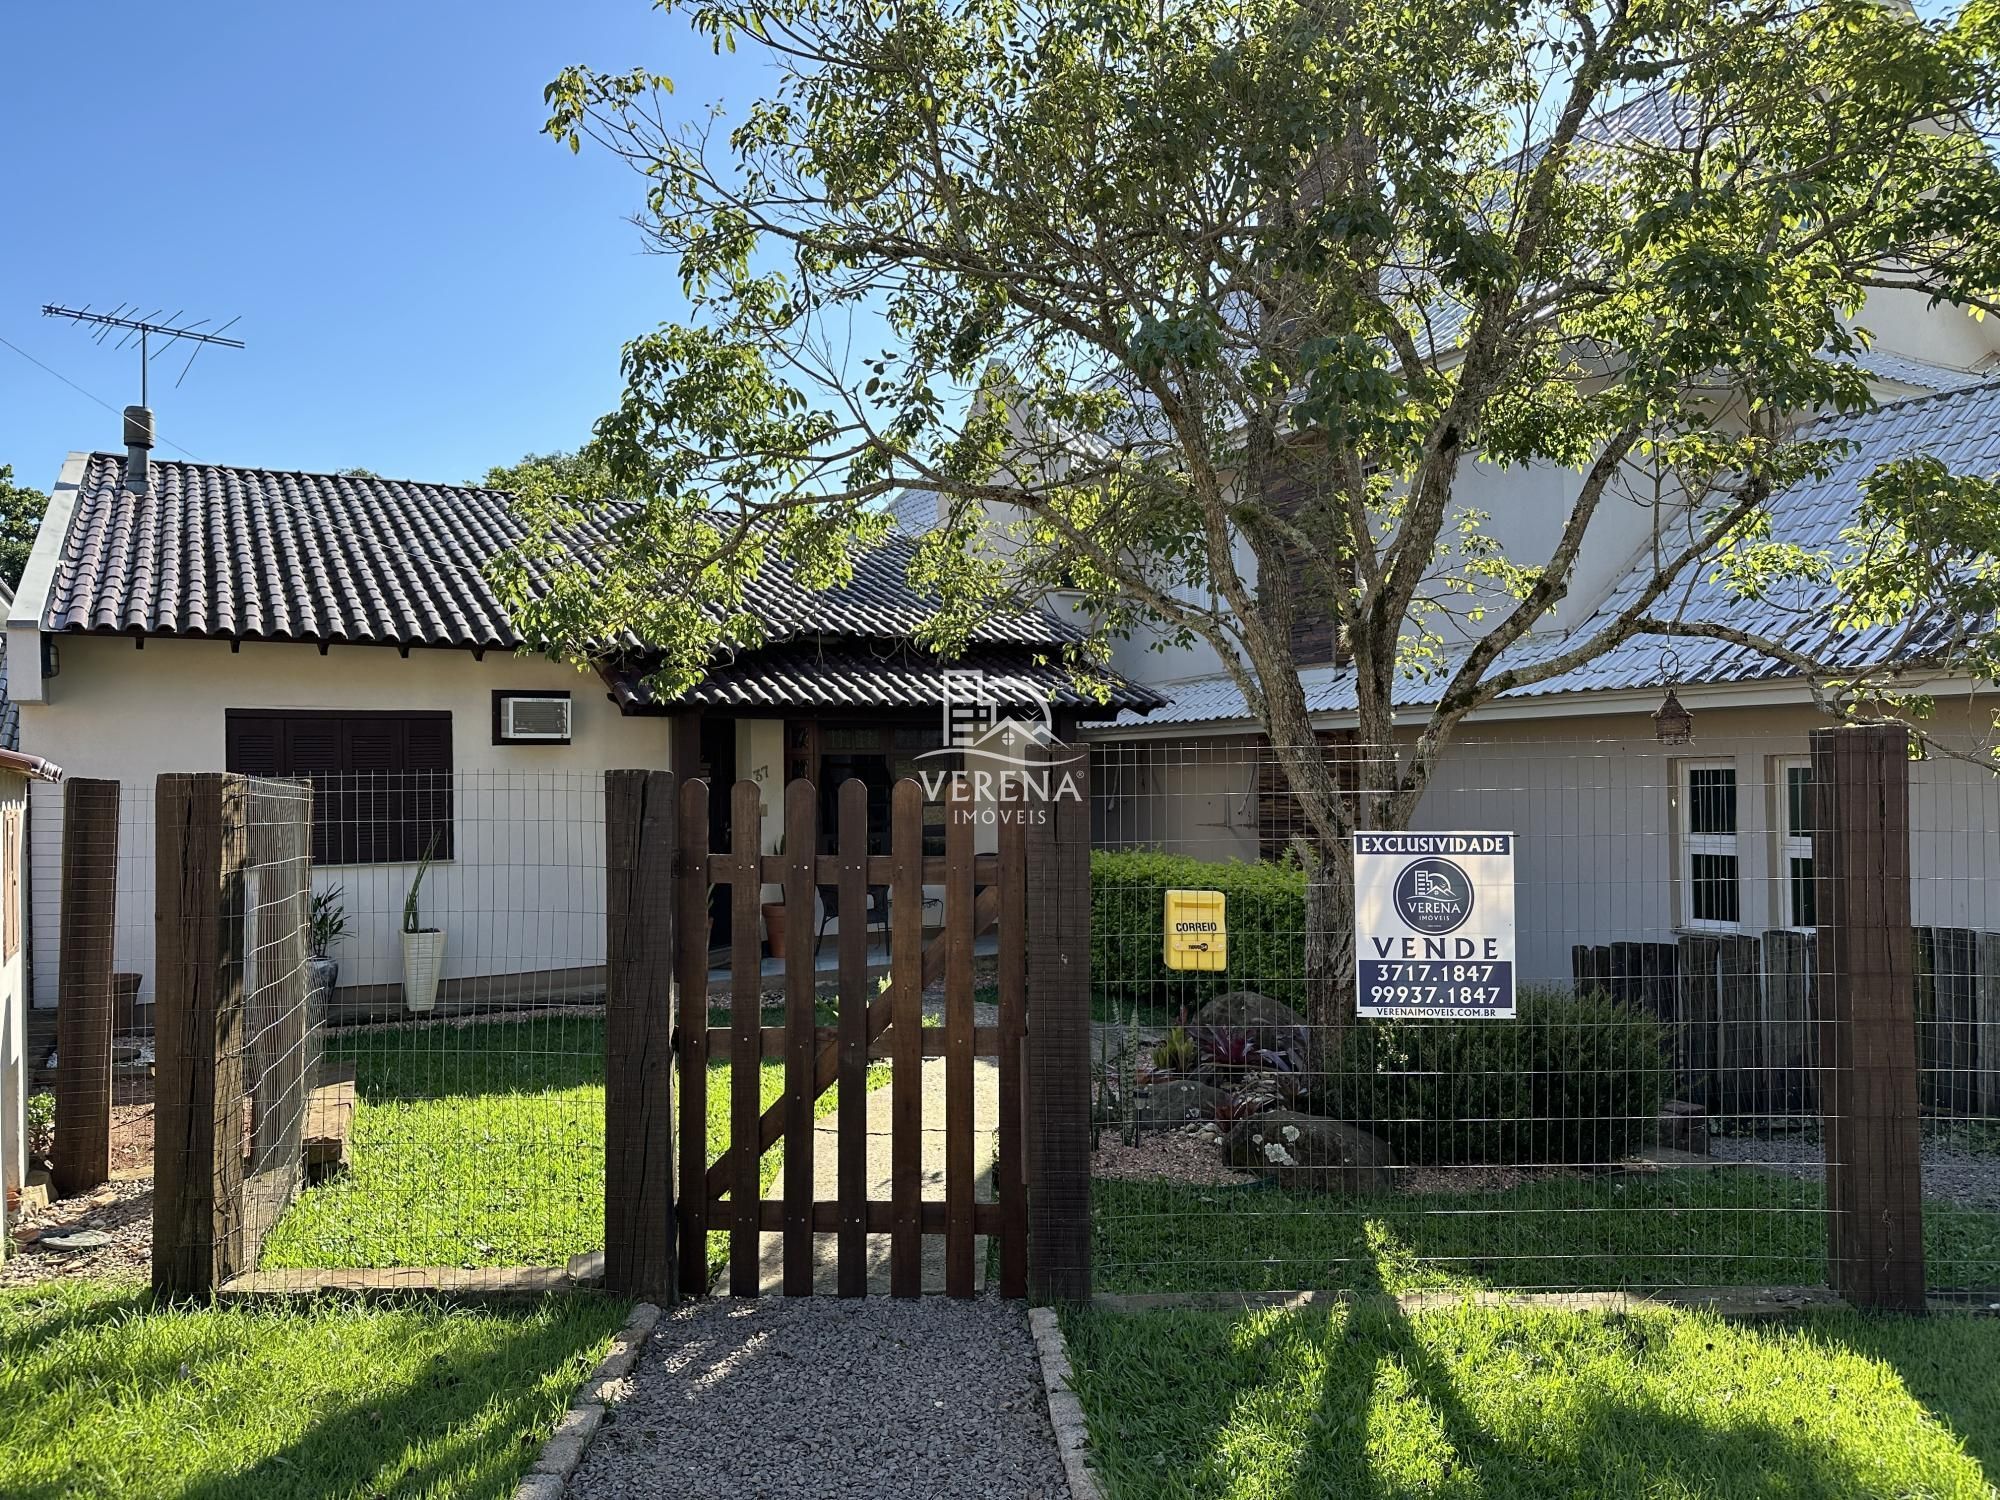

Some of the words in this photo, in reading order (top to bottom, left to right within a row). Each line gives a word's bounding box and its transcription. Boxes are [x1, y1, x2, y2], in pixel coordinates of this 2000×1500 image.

[1361, 837, 1505, 853] EXCLUSIVIDADE
[1407, 902, 1461, 914] VERENA
[1419, 913, 1450, 921] IMÓVEIS
[1175, 922, 1217, 932] CORREIO
[1371, 937, 1499, 960] VENDE
[1377, 964, 1494, 982] 3717.1847
[1370, 986, 1501, 1004] 99937.1847
[1376, 1007, 1496, 1017] VERENAIMOVEIS.COM.BR
